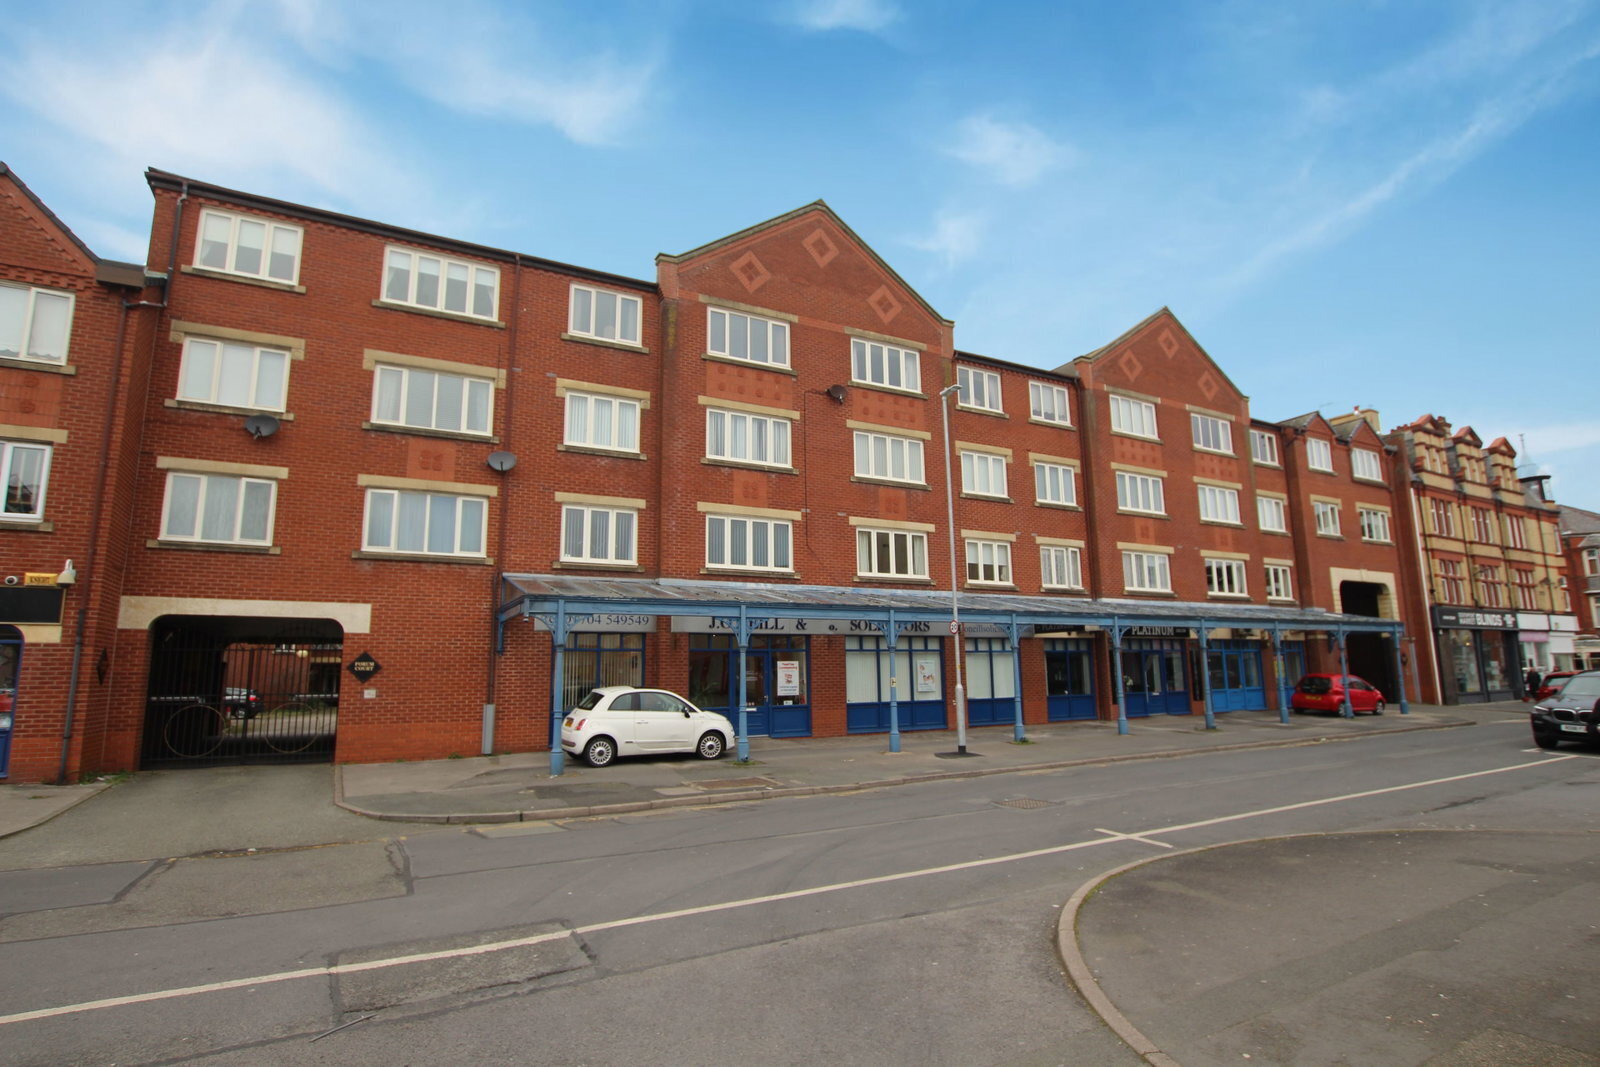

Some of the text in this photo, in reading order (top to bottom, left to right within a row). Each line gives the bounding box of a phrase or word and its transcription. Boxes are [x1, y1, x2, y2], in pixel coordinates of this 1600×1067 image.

[606, 615, 648, 625] 549549
[796, 618, 807, 630] &
[1476, 613, 1502, 626] BLINDS
[1131, 626, 1174, 635] PLATINUM
